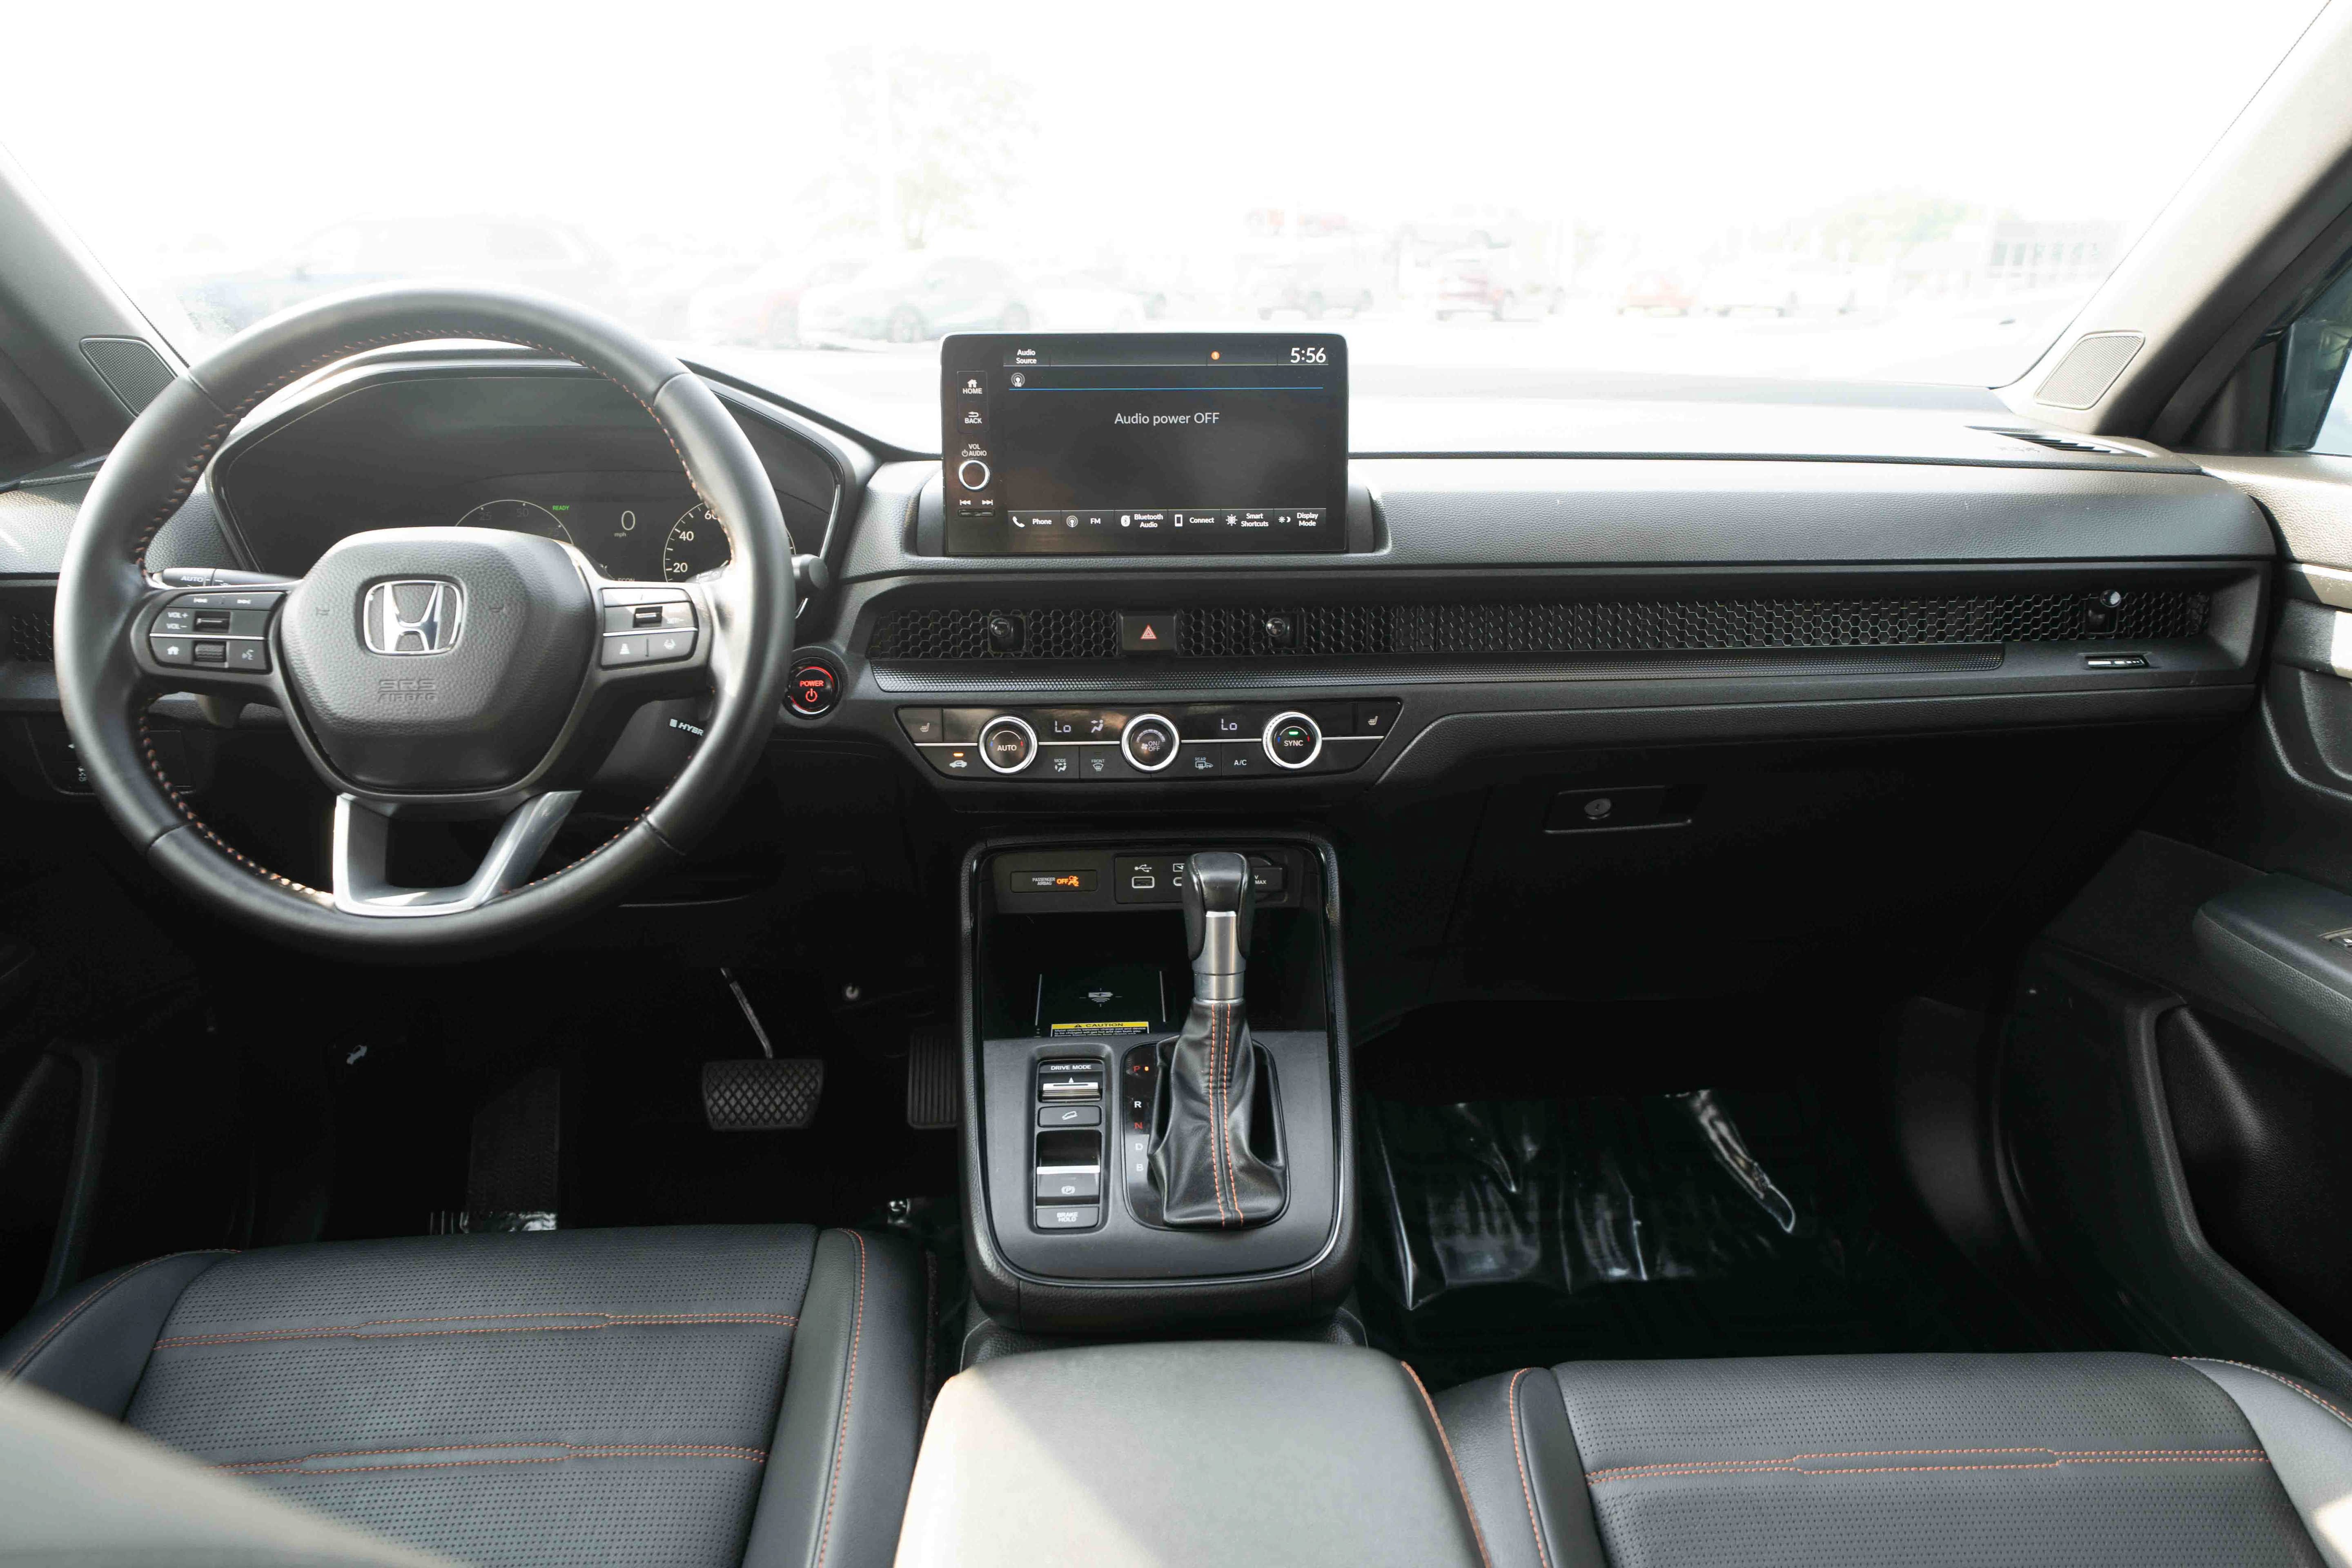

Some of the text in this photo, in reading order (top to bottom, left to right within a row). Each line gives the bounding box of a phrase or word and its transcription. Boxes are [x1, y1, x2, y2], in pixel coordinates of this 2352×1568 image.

[1290, 347, 1326, 363] 5:56
[1114, 412, 1220, 426] Audio power OFF
[621, 510, 636, 531] 0
[679, 531, 694, 541] 40
[673, 562, 688, 572] 20
